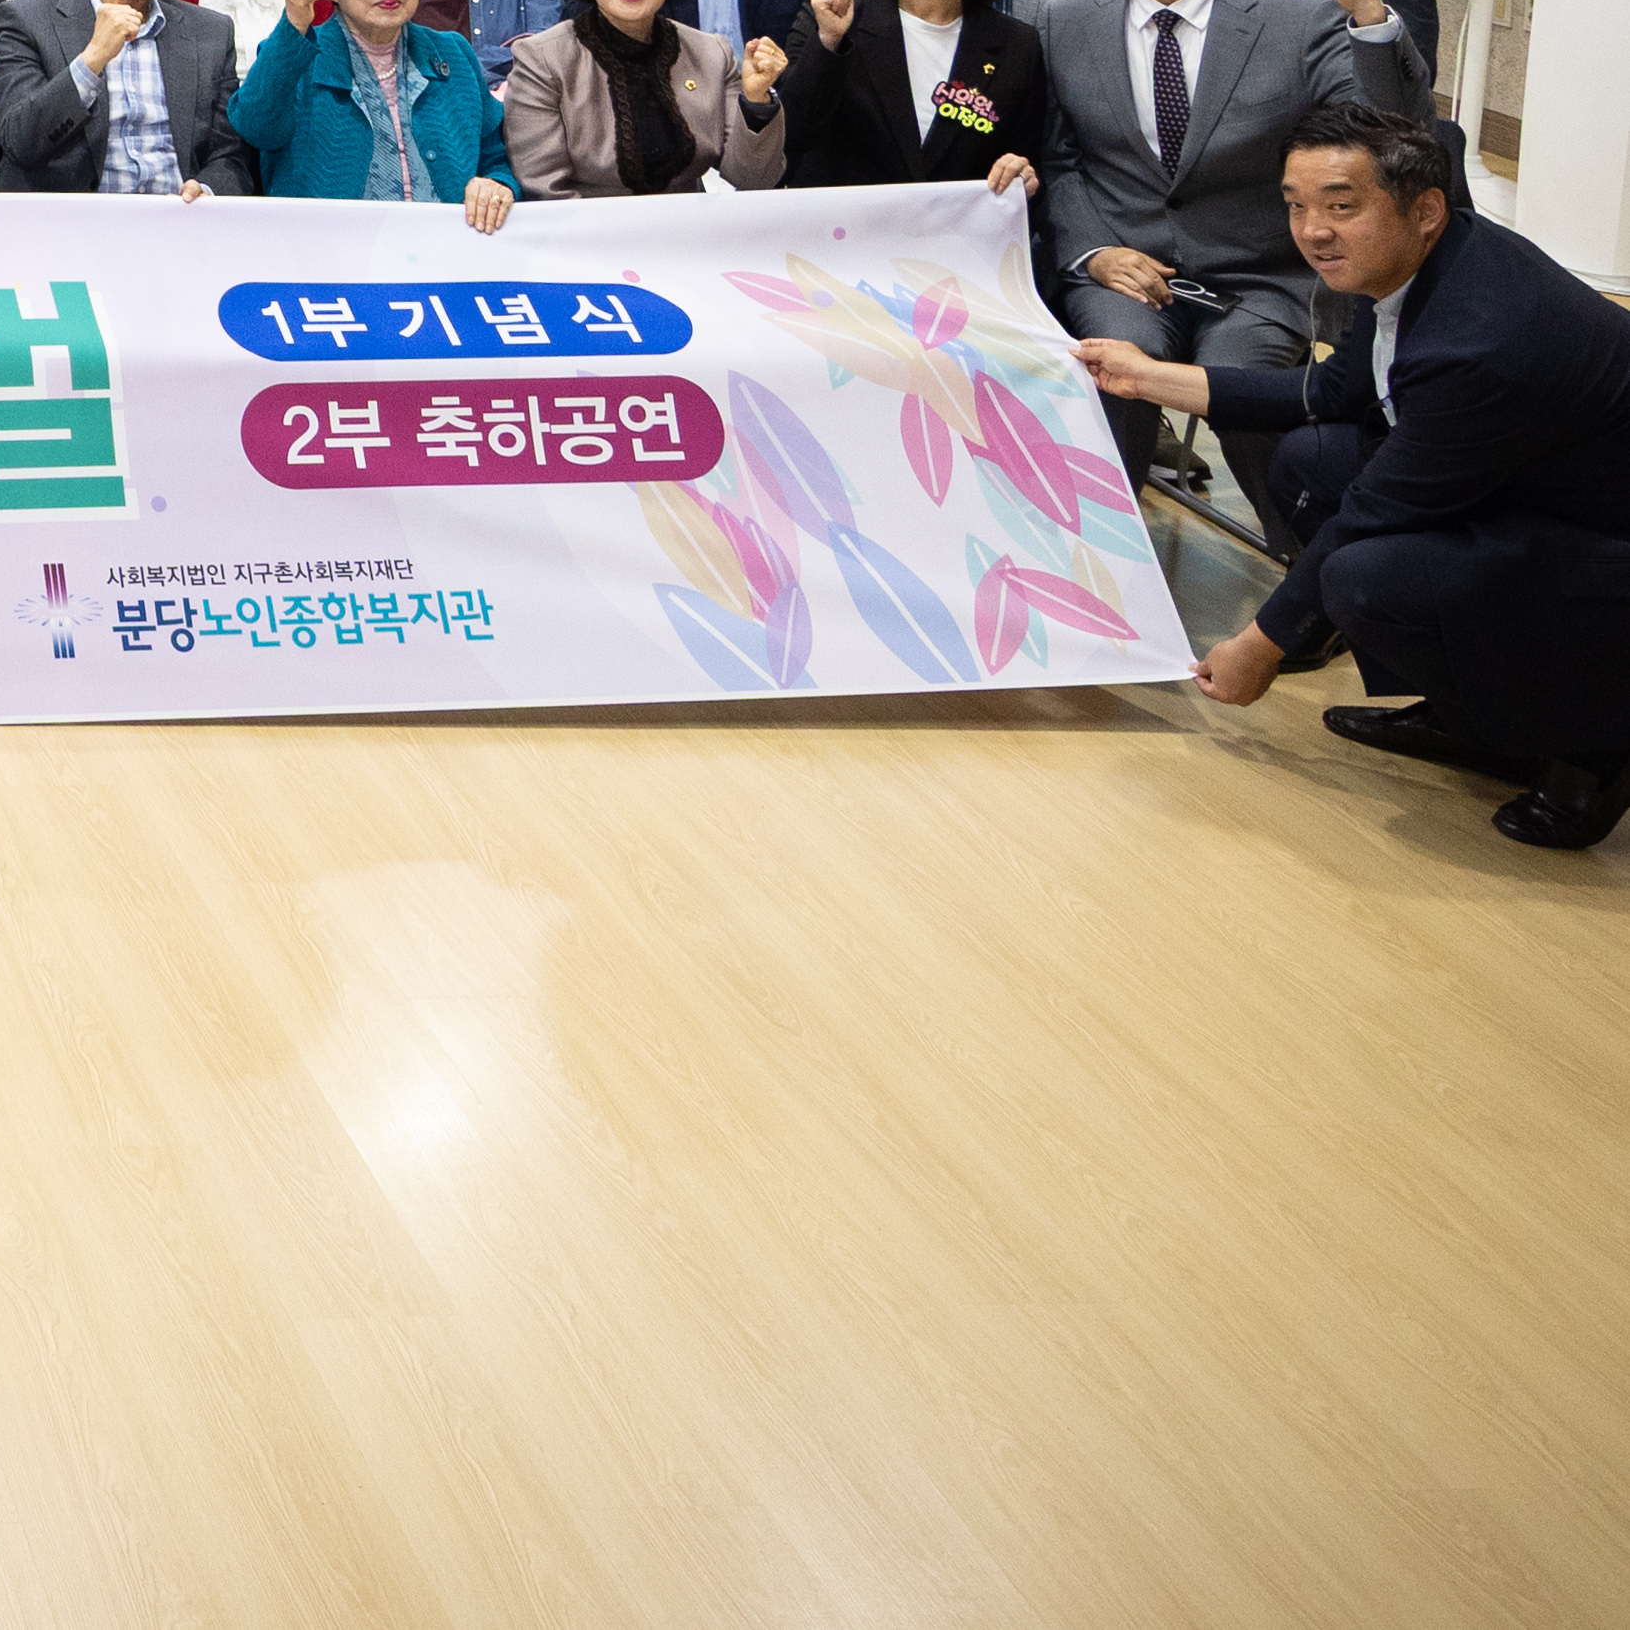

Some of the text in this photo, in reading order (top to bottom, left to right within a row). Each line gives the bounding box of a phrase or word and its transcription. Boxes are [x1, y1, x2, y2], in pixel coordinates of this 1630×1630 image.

[262, 298, 367, 347] 1부
[284, 393, 685, 468] 2부 축하공연
[107, 559, 413, 588] 사회복지법인 지구촌사회복지재단
[112, 590, 494, 652] 분당노인종합복지관
